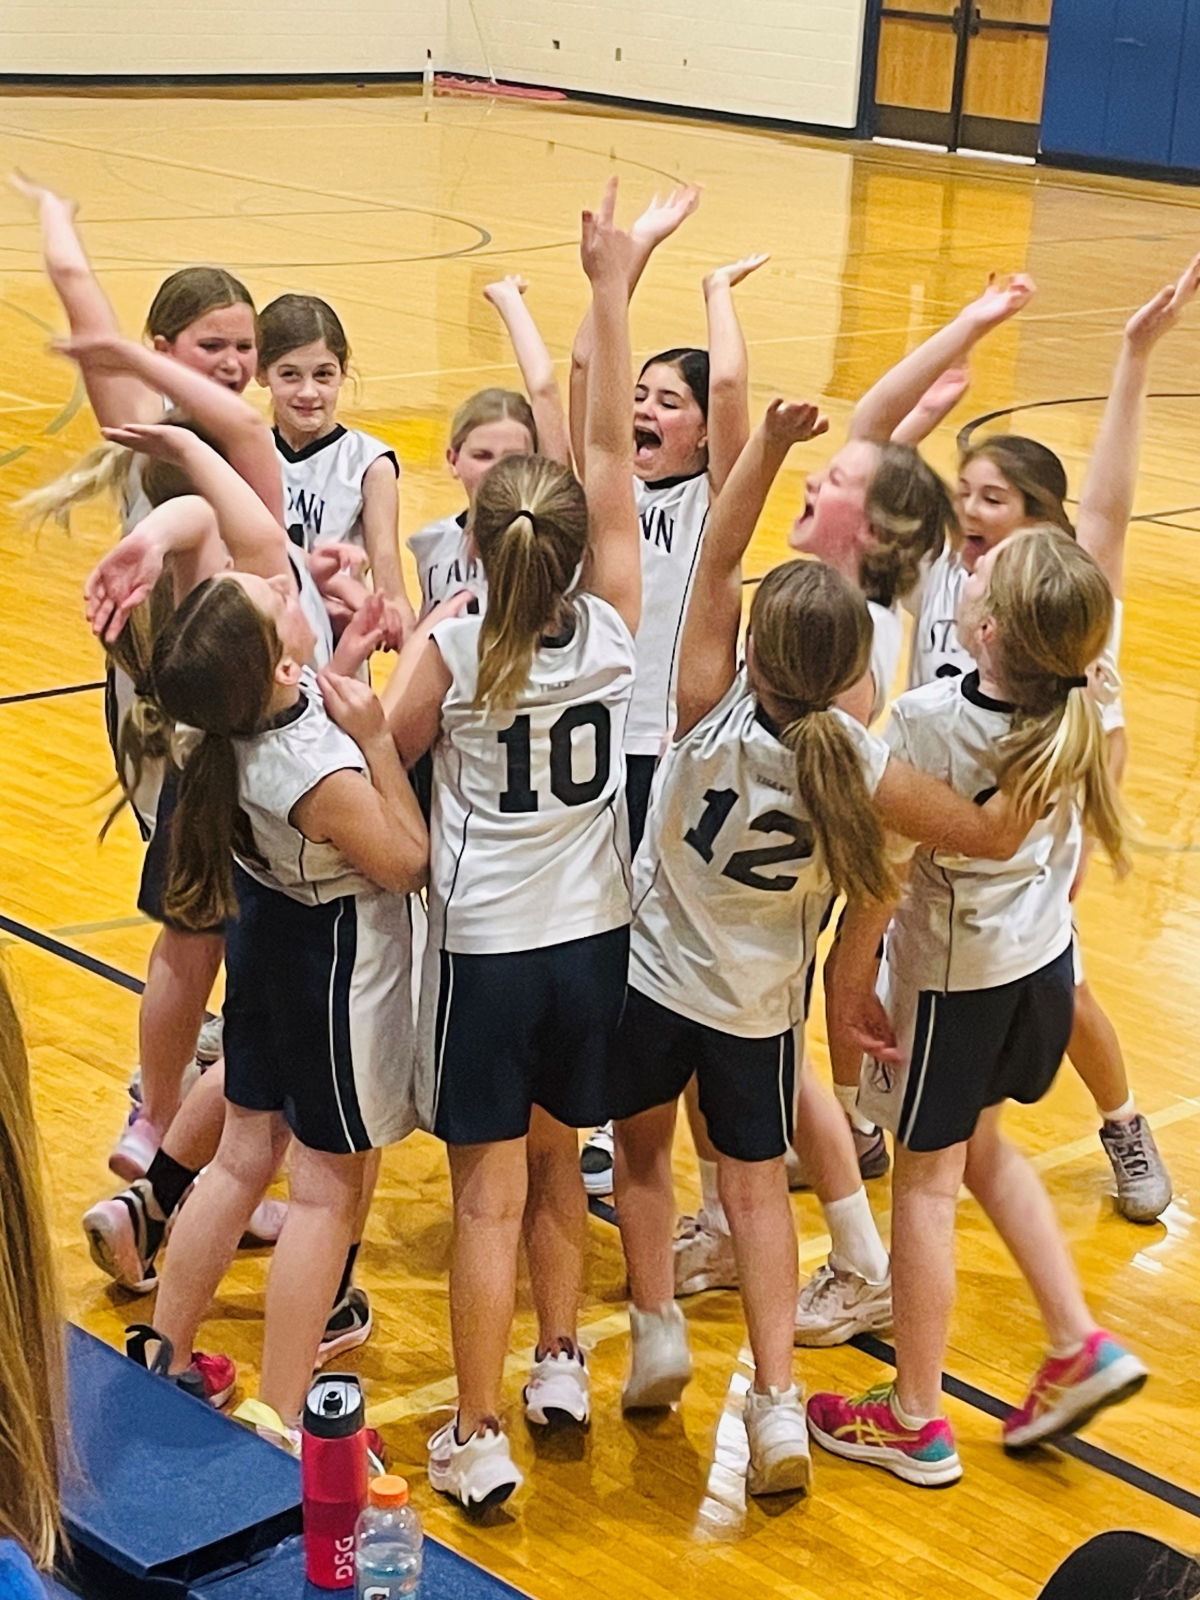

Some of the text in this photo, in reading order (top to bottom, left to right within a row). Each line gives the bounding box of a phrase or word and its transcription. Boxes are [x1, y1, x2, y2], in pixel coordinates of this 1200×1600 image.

[497, 700, 611, 813] 10
[683, 787, 815, 892] 12
[334, 1535, 354, 1580] DSG
